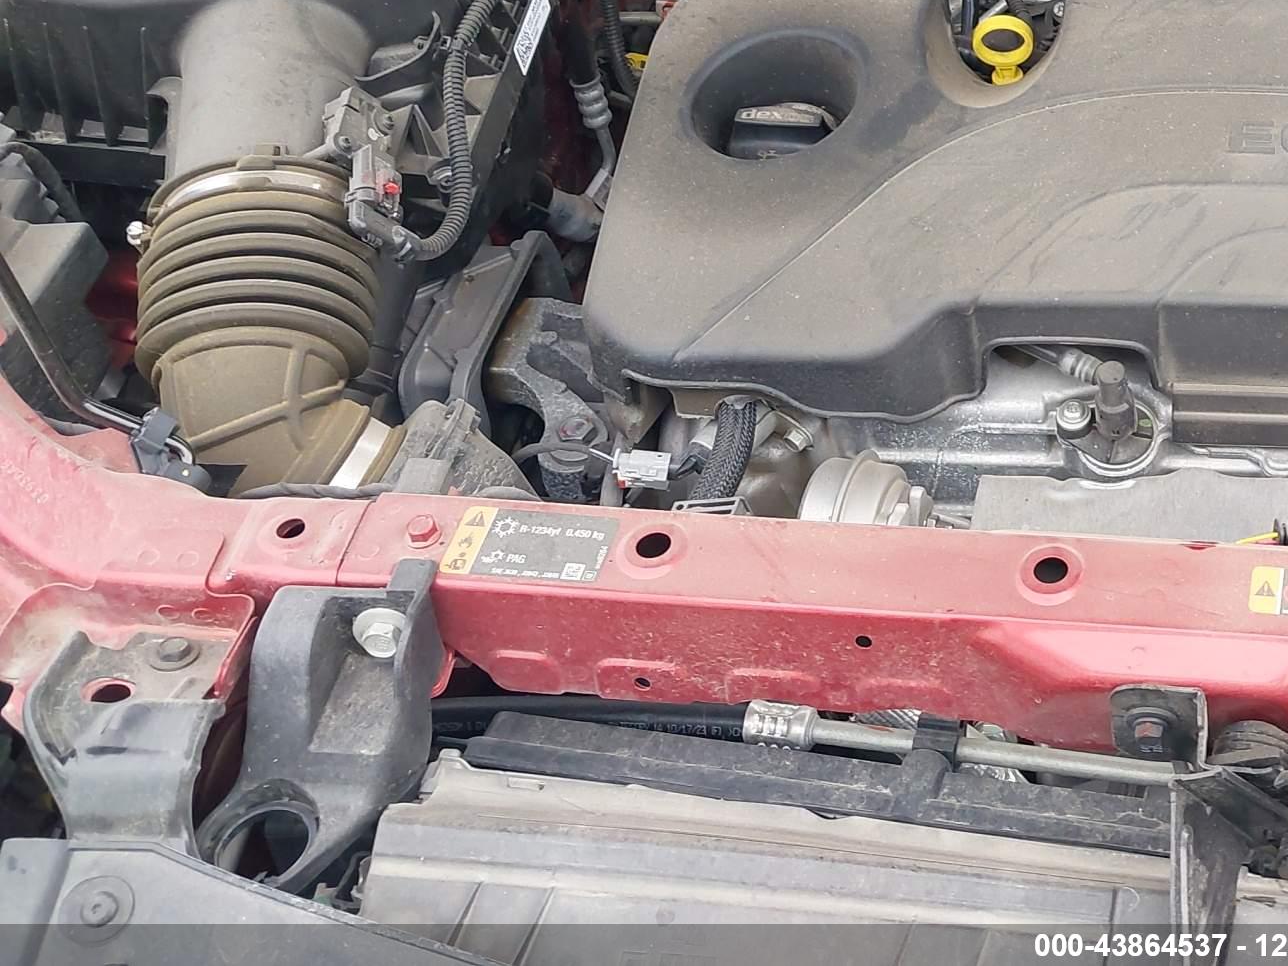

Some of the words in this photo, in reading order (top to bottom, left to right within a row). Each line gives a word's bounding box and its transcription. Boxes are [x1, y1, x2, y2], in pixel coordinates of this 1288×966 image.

[519, 524, 562, 537] R-1234yf
[566, 528, 592, 538] 0.450
[592, 530, 605, 541] kg
[505, 553, 527, 564] PAG
